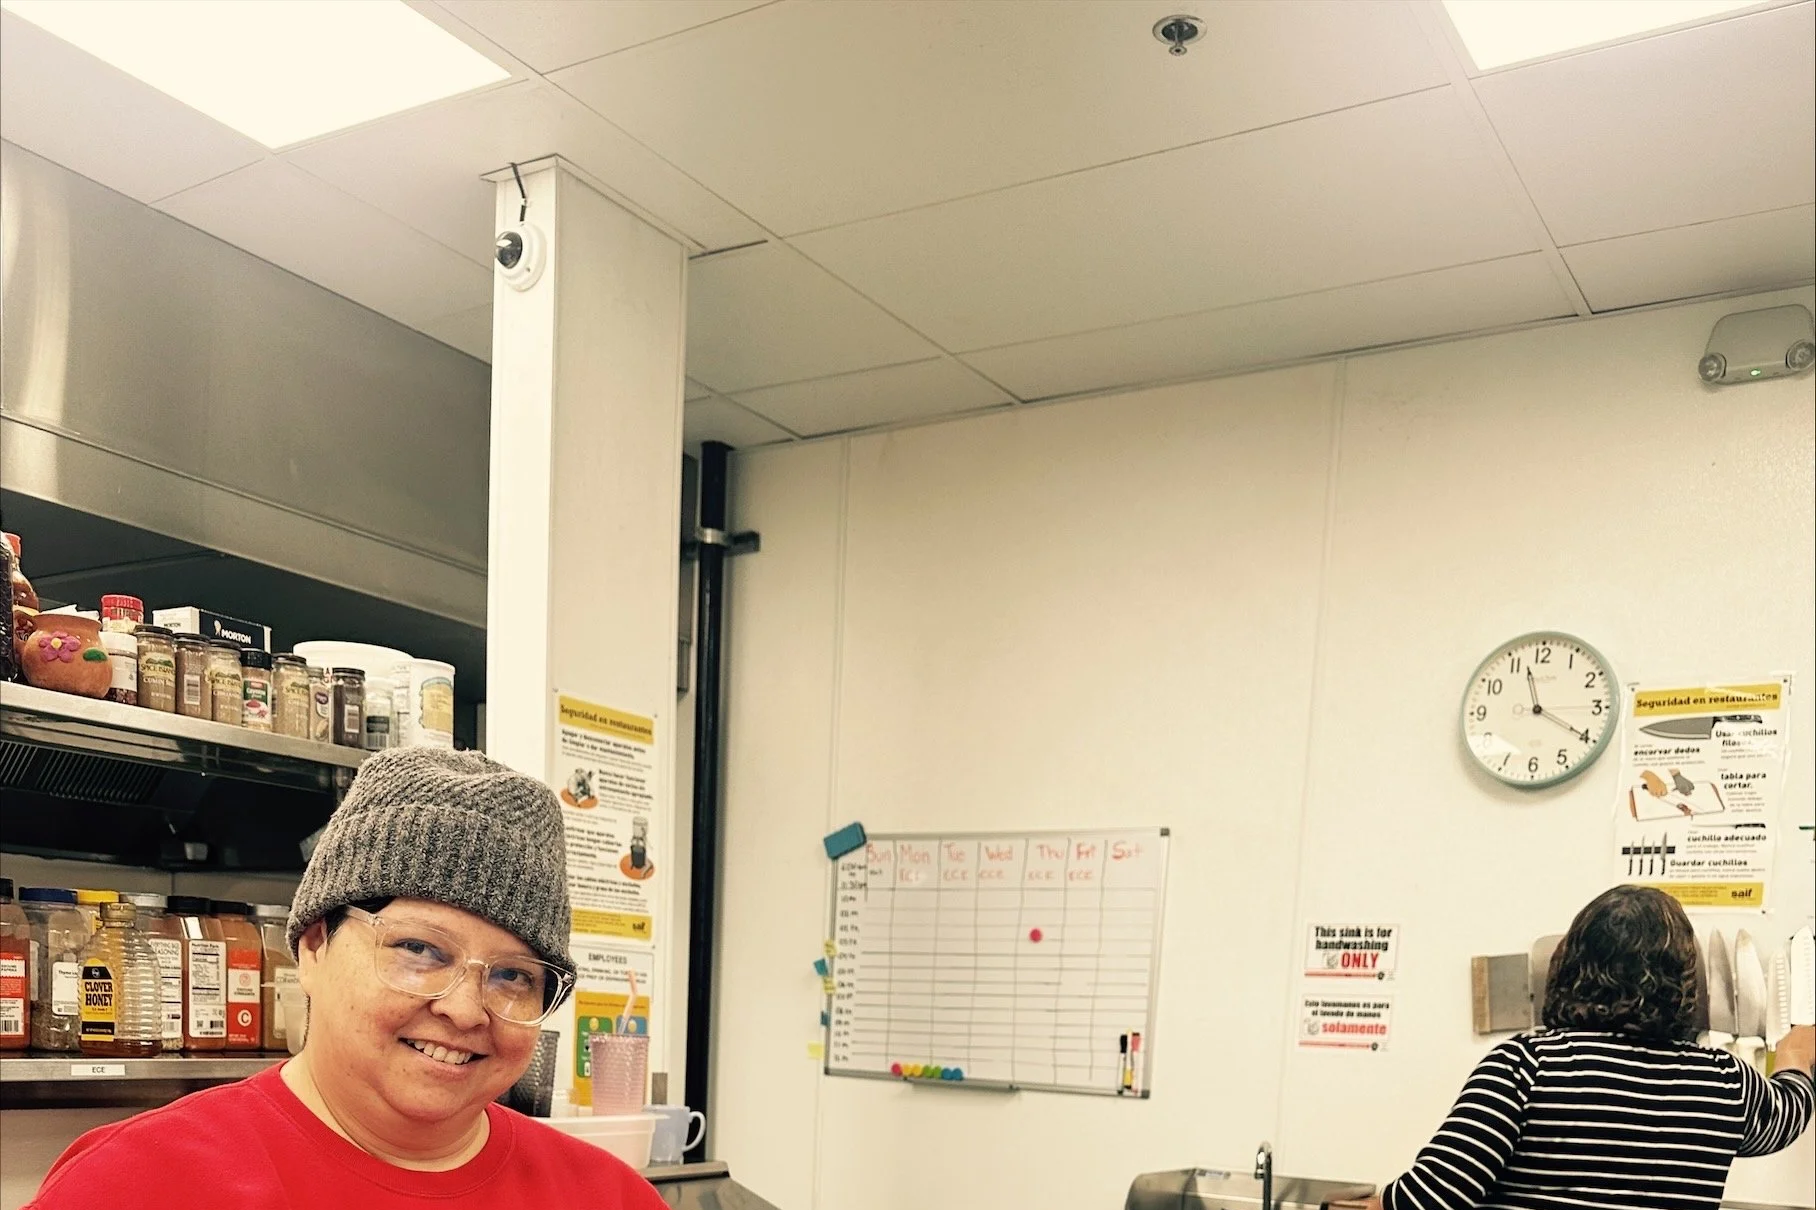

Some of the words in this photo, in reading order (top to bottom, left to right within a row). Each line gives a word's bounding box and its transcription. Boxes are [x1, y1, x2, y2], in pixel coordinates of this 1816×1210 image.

[221, 629, 252, 644] MORTON
[1535, 647, 1551, 664] 12
[1568, 654, 1573, 670] 1
[1510, 657, 1520, 674] 11
[1487, 679, 1503, 696] 10
[1584, 672, 1596, 689] 2
[1592, 700, 1602, 716] 3
[1636, 696, 1690, 710] Seguridad
[560, 704, 598, 722] Seguridad
[599, 716, 608, 724] en
[610, 720, 652, 736] restaurantes
[1476, 705, 1487, 721] 9
[1579, 729, 1590, 744] 4
[1556, 749, 1567, 765] 5
[1634, 748, 1670, 756] encorvar
[1674, 746, 1700, 754] dedos
[1528, 757, 1538, 772] 6
[1746, 772, 1766, 780] para
[1688, 834, 1722, 842] cuchillo
[1724, 834, 1766, 842] adecuado
[866, 843, 891, 865] Sun
[900, 844, 930, 865] Mon
[944, 842, 966, 863] Tue
[985, 844, 1014, 862] Wed
[1036, 843, 1064, 860] Thu
[1076, 842, 1096, 860] Fri
[1112, 841, 1142, 862] Sat
[1731, 889, 1752, 898] saif
[1315, 926, 1336, 938] This
[1339, 928, 1362, 938] sink
[1364, 928, 1374, 938] is
[1376, 928, 1392, 938] for
[1315, 940, 1388, 952] handwashing
[588, 953, 628, 964] EMPLOYEES
[1341, 952, 1379, 968] ONLY
[84, 982, 113, 993] CLOVER
[85, 994, 113, 1006] HONEY
[241, 1012, 250, 1024] C
[1322, 1022, 1387, 1035] solamente
[92, 1066, 106, 1074] ECE
